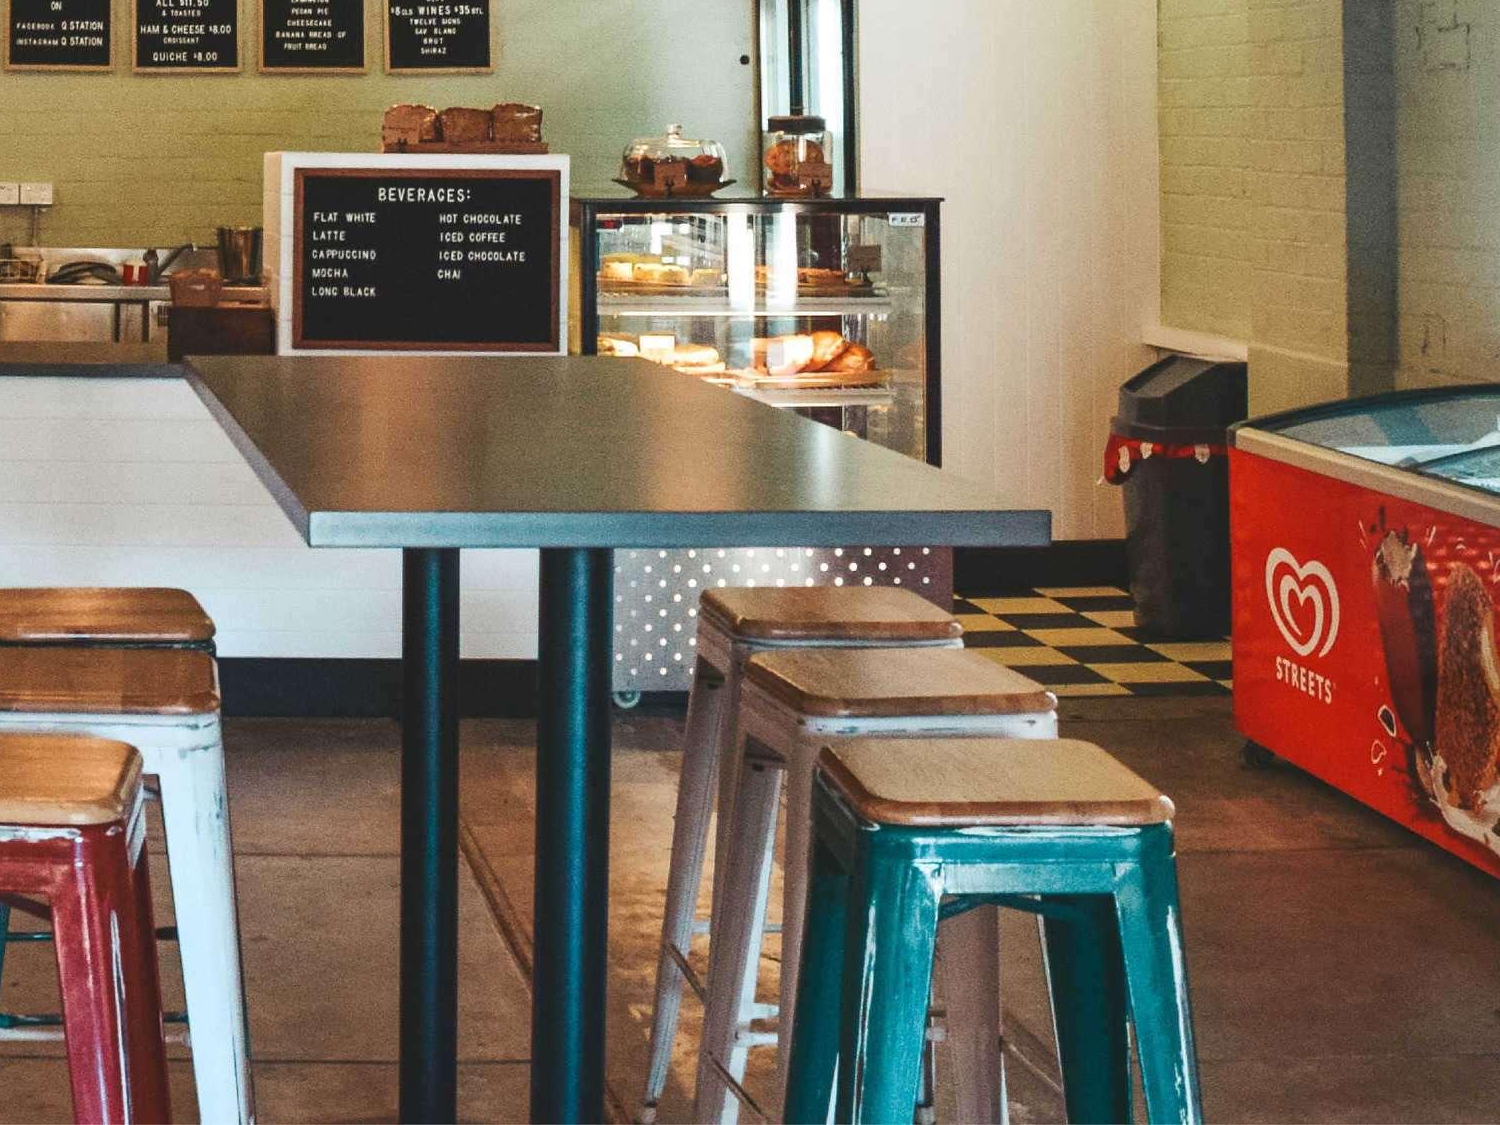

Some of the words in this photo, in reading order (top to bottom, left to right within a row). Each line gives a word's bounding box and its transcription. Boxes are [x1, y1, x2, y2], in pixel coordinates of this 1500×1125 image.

[50, 1, 62, 11] ON
[417, 5, 451, 15] WINES
[16, 22, 55, 30] FACEBOOK
[61, 21, 67, 30] Q
[69, 21, 104, 31] STATION
[287, 19, 332, 27] CHEESECAKE
[141, 25, 160, 34] HAM
[163, 24, 169, 34] &
[171, 24, 206, 34] CHEESE
[209, 25, 232, 34] $8.00
[16, 38, 59, 46] INSTAGRAM
[69, 37, 103, 46] STATION
[284, 43, 302, 51] FRUIT
[305, 43, 327, 51] BREAD
[421, 47, 447, 55] SHIRAZ
[153, 52, 188, 62] QUICHE
[378, 187, 471, 203] BEVERAGES:
[313, 212, 338, 223] FLAT
[345, 212, 376, 223] WHITE
[439, 213, 458, 224] HOT
[463, 213, 522, 225] CHOCOLATE
[313, 231, 346, 241] LATTE
[440, 232, 464, 243] ICED
[469, 232, 506, 243] COFFEE
[312, 249, 377, 260] CAPPUCCINO
[439, 251, 464, 261] ICED
[467, 251, 526, 262] CHOCOLATE
[312, 268, 349, 278] MOCHA
[437, 269, 461, 279] CHAI
[311, 286, 338, 296] LONG
[343, 286, 376, 296] BLACK
[1276, 655, 1332, 704] STREETS
